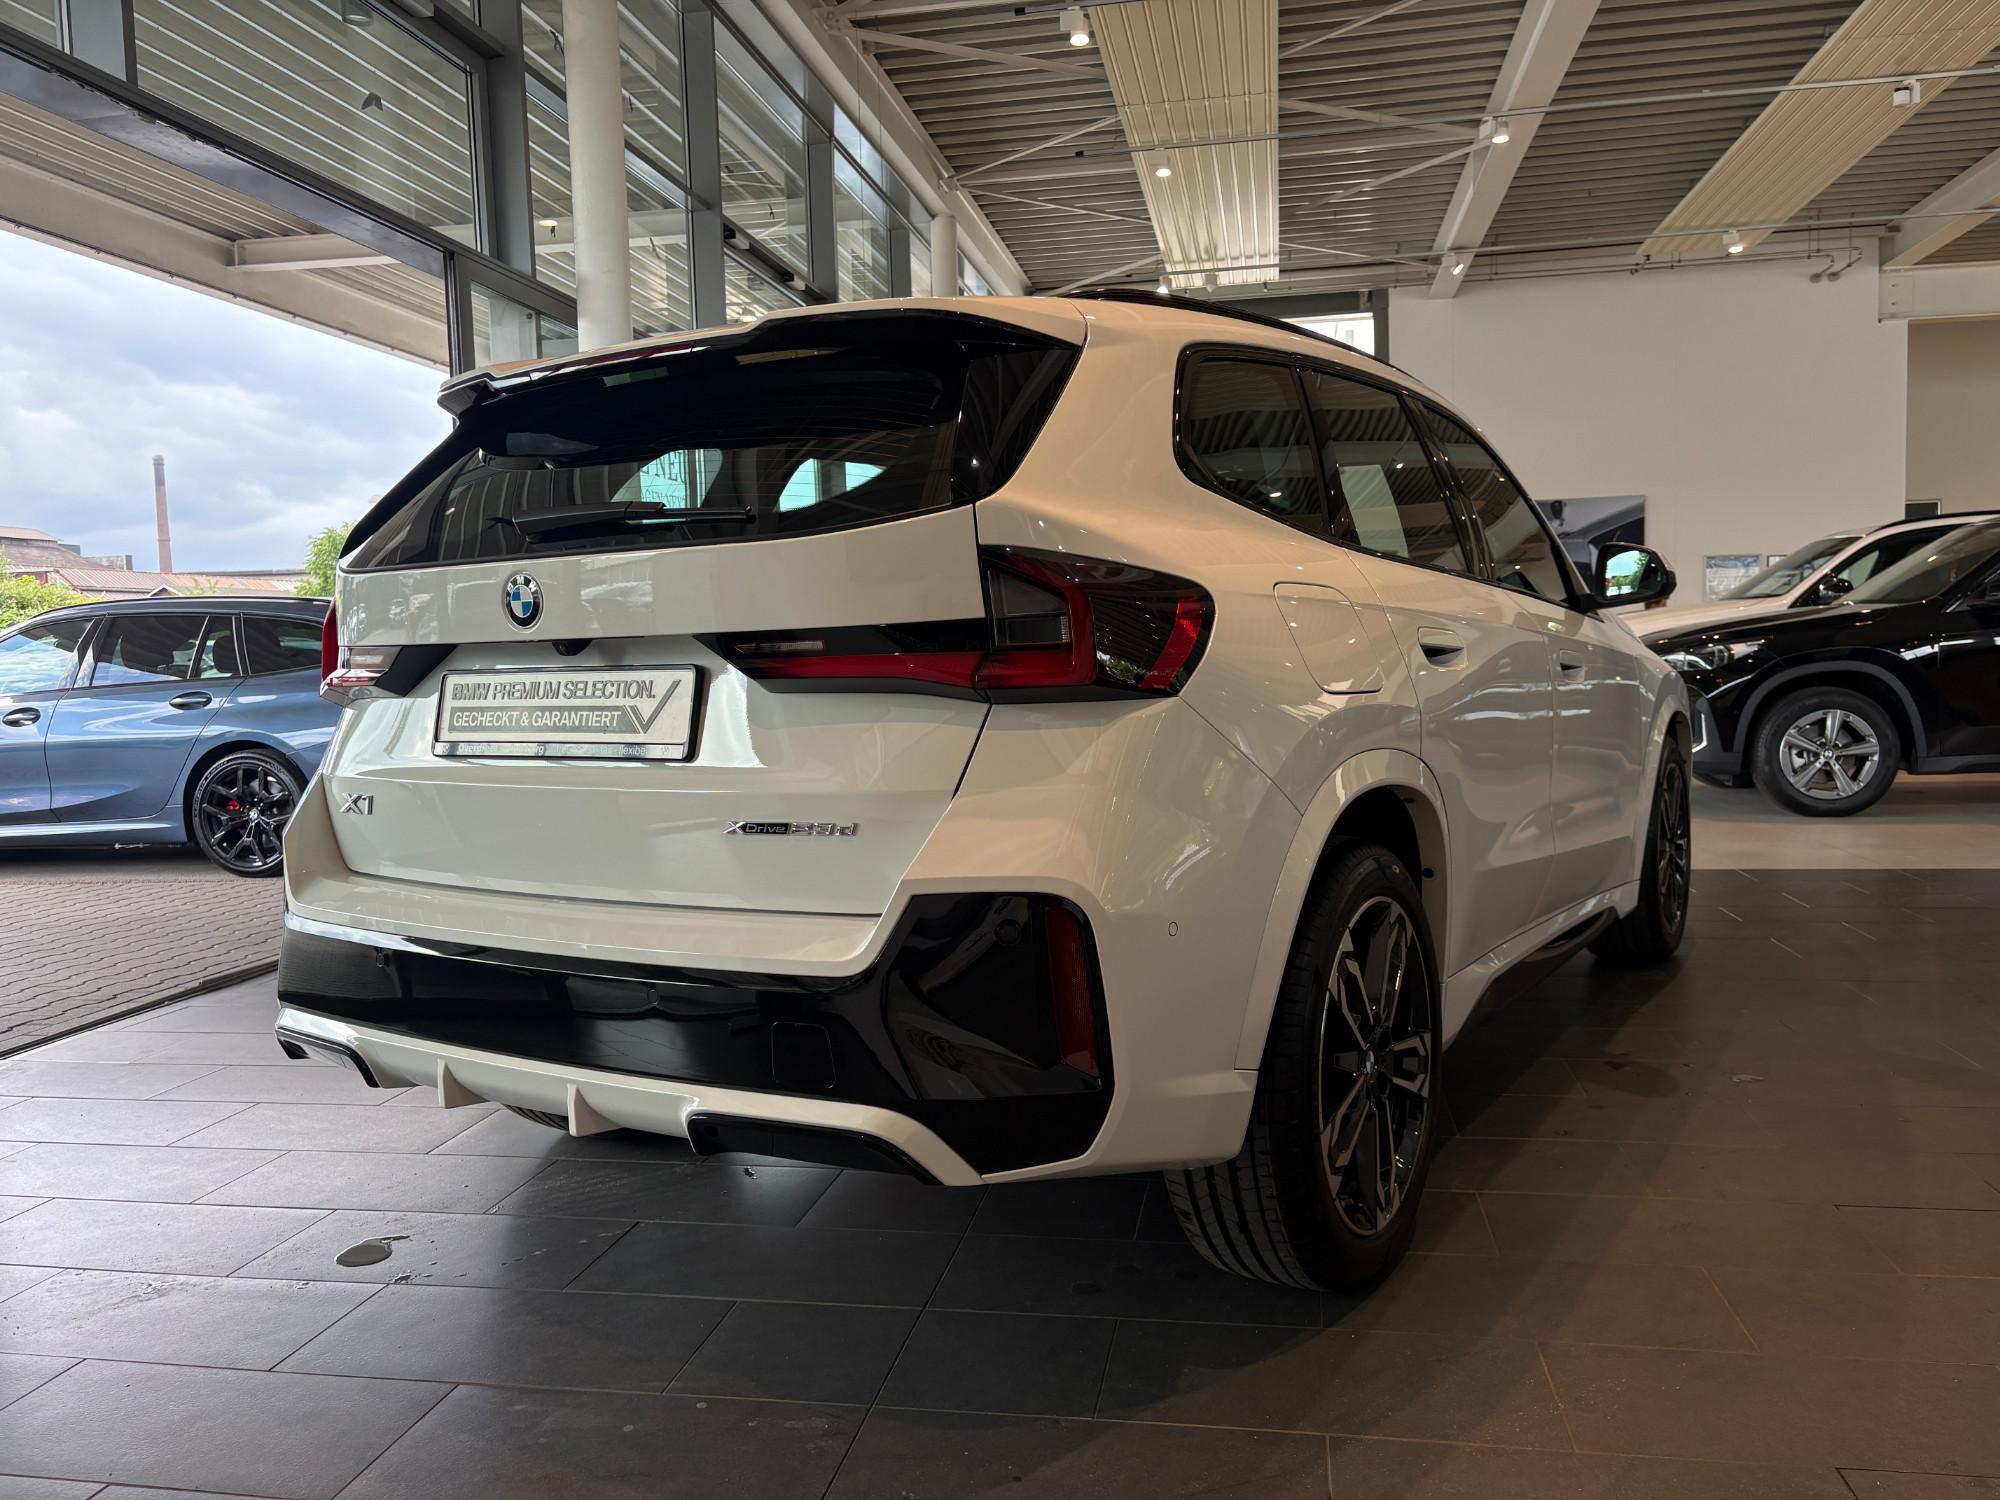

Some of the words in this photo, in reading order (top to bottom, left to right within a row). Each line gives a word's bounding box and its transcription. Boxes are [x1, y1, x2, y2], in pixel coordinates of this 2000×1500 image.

[452, 683, 491, 700] BMW
[492, 681, 561, 700] PREMIUM
[562, 679, 656, 699] SELECTION.
[453, 711, 519, 727] GECHECKT
[520, 711, 529, 726] &
[531, 711, 622, 727] GARANTIERT
[340, 793, 374, 815] X1
